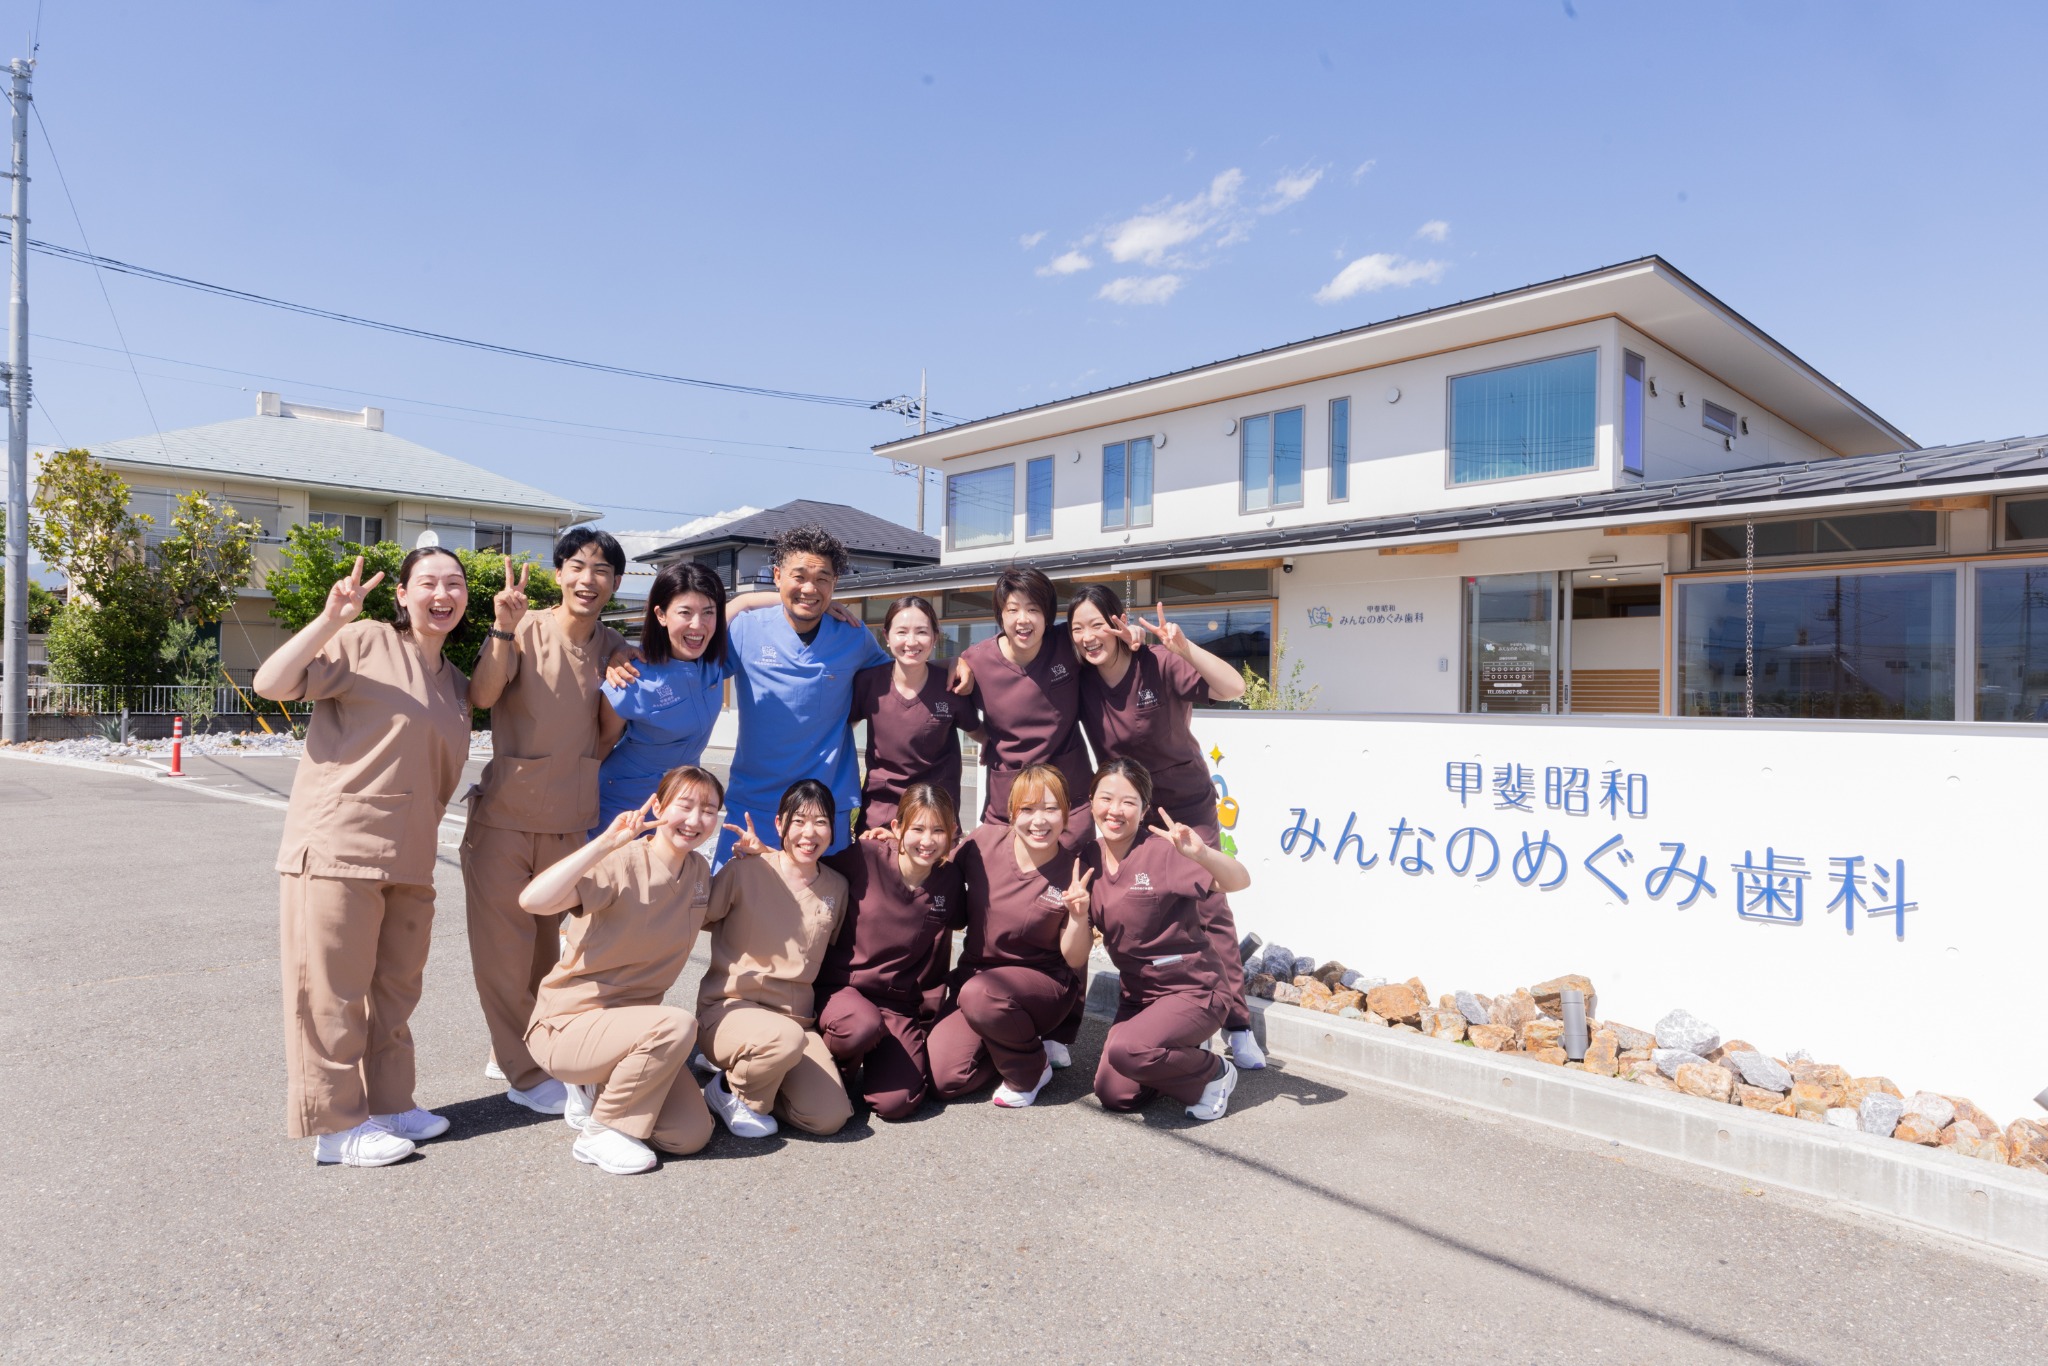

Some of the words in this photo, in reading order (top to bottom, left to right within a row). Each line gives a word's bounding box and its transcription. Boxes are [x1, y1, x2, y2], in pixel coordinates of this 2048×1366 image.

[1339, 612, 1425, 626] みんなのめぐみ歯科
[1445, 761, 1650, 818] 甲斐昭和
[1280, 807, 1919, 938] みんなのめぐみ歯科
